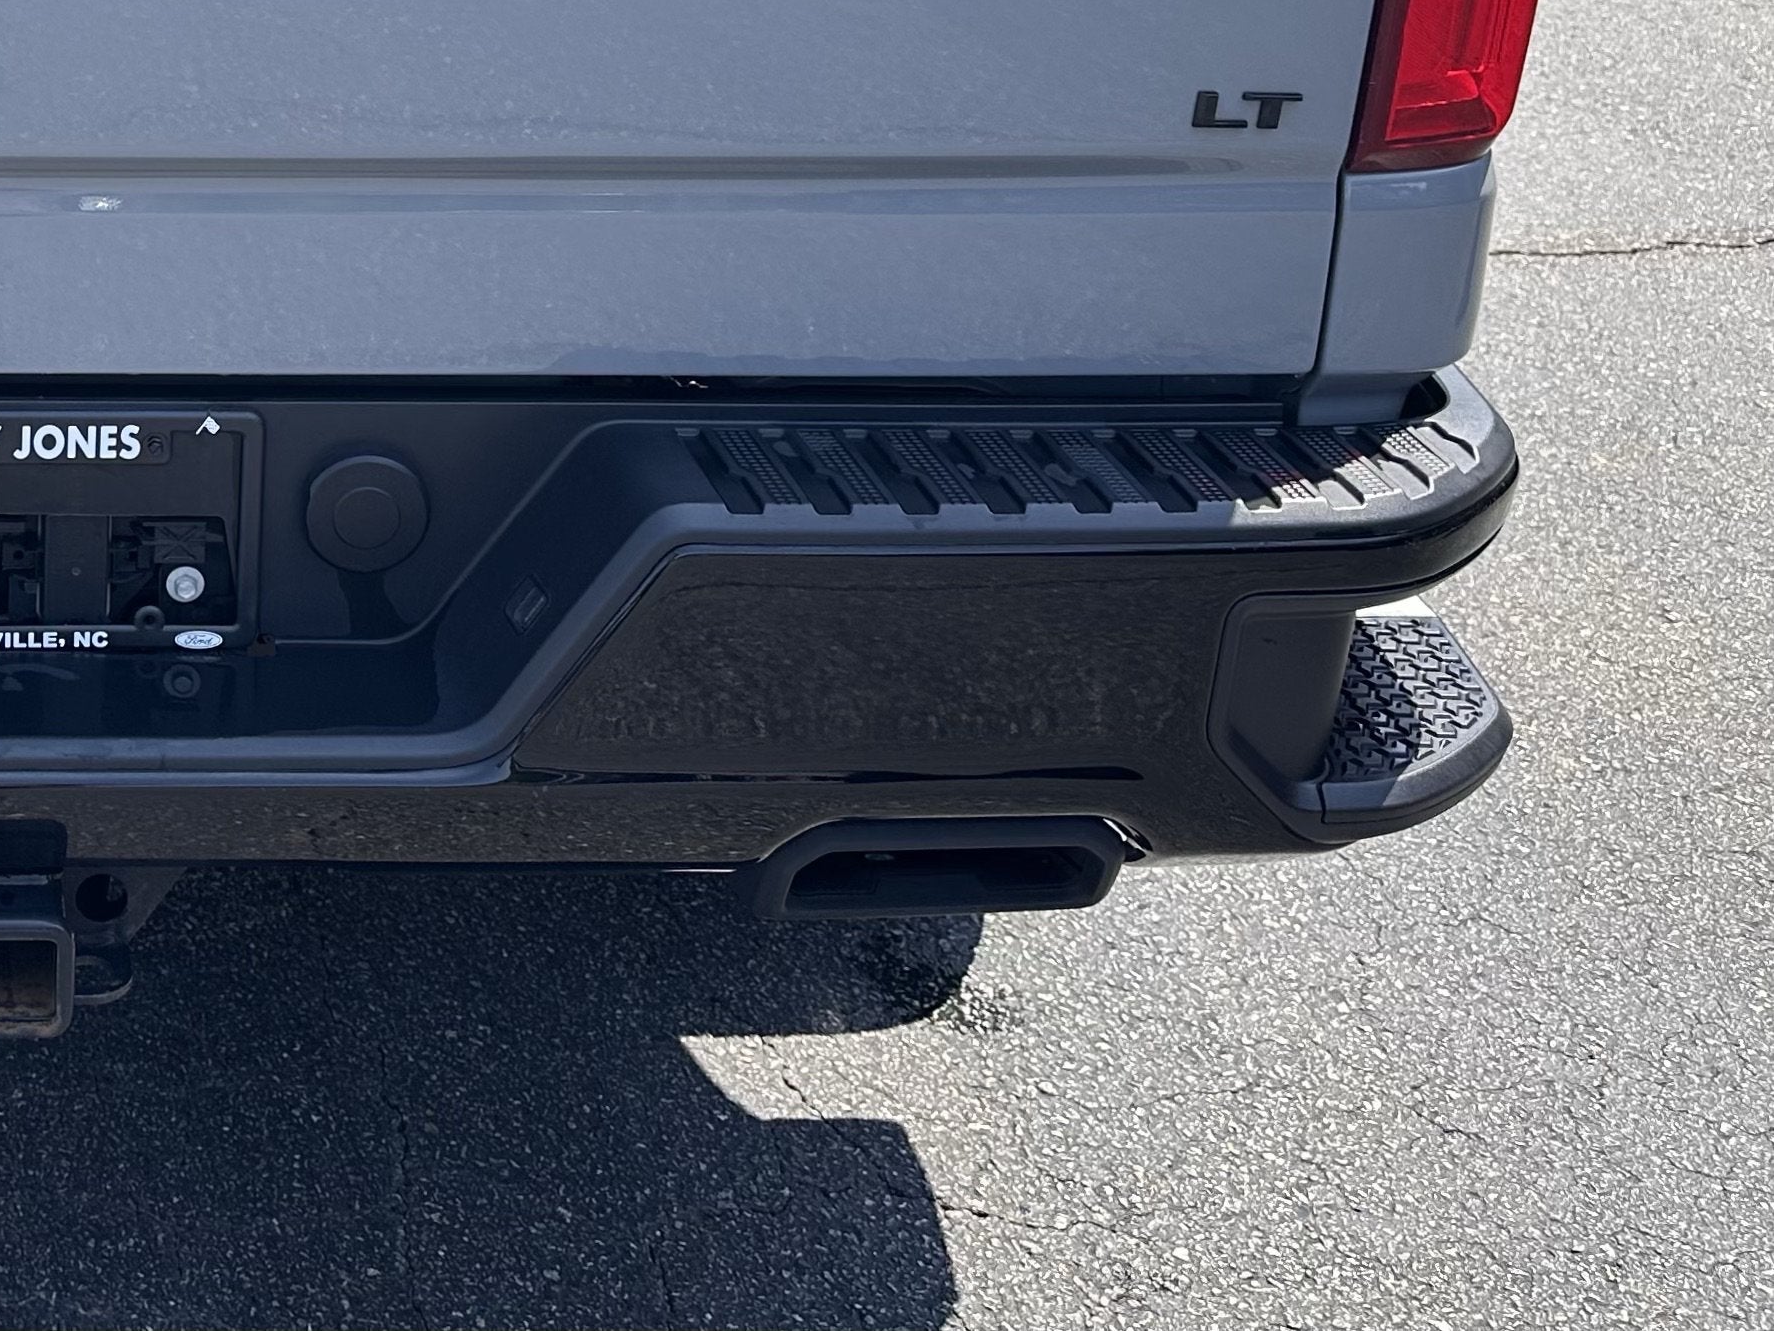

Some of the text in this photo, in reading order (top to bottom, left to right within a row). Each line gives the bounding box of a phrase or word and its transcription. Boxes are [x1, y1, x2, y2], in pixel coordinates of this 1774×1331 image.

[1191, 91, 1304, 129] LT
[13, 424, 141, 460] JONES
[73, 631, 109, 648] NC
[182, 633, 216, 647] Ford
